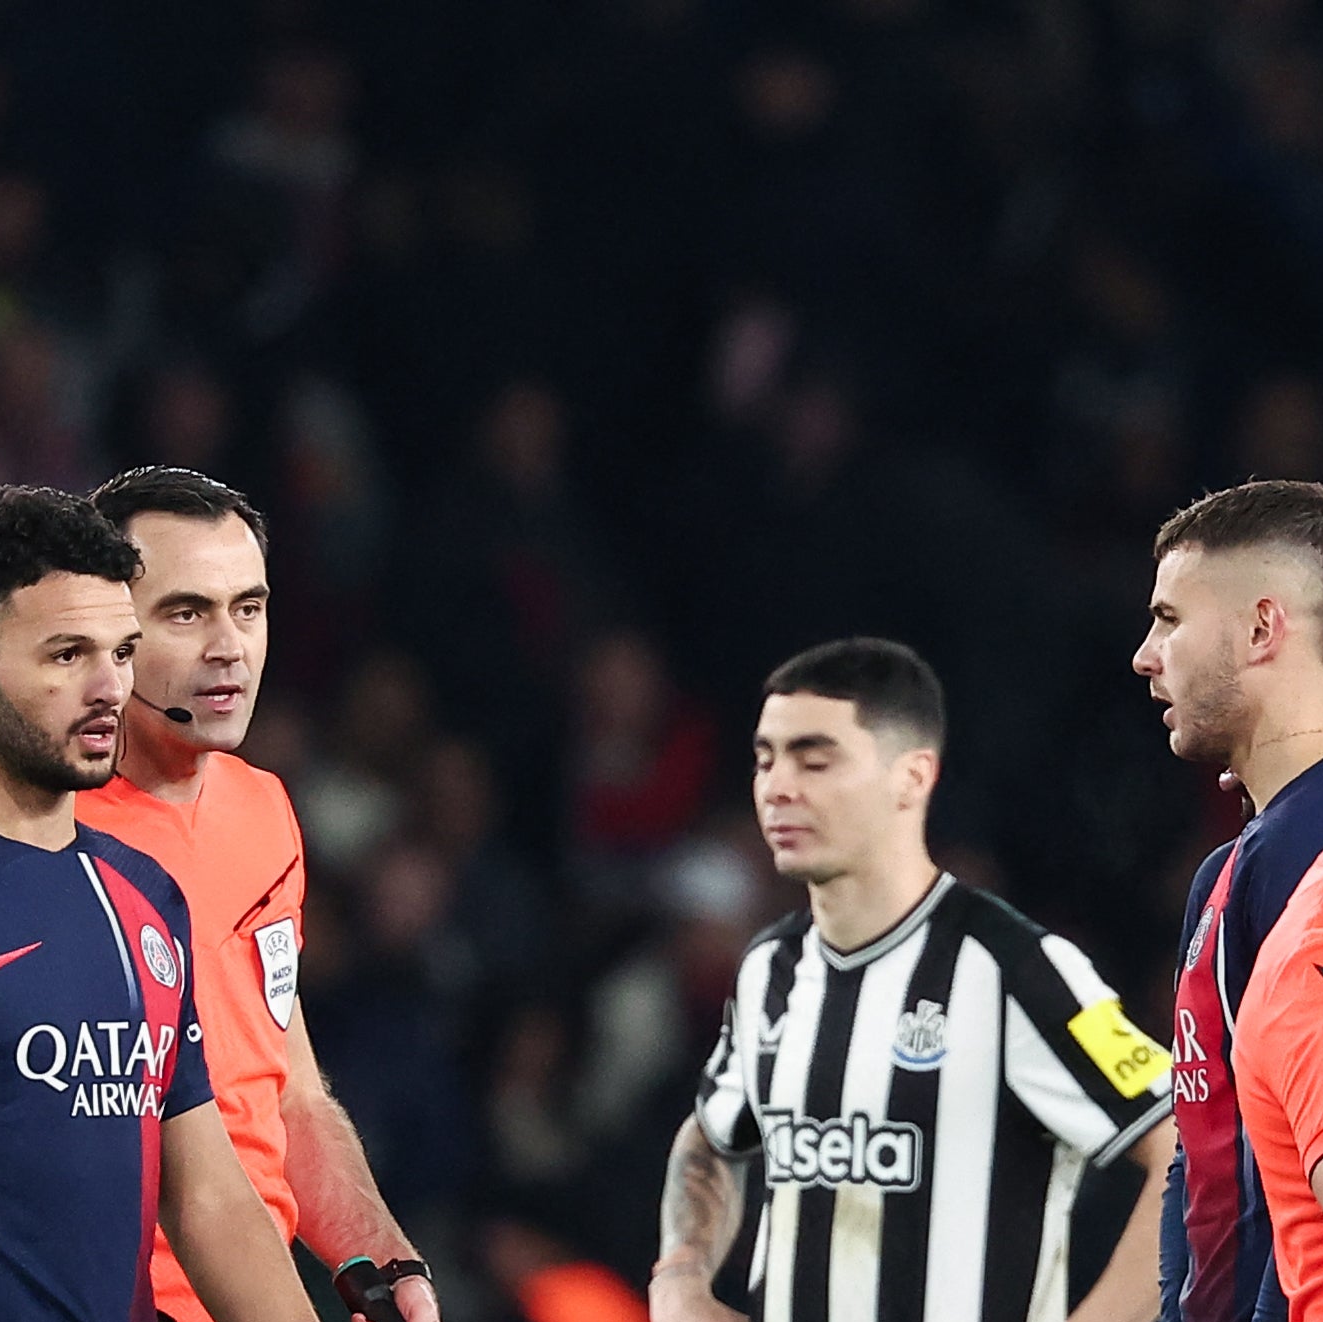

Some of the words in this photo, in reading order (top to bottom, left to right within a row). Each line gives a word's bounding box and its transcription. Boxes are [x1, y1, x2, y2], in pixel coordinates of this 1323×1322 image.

[264, 933, 289, 956] UEFA
[272, 965, 292, 981] MATCH
[269, 985, 293, 999] OFFICIAL
[16, 1021, 176, 1092] QATAR
[793, 1115, 913, 1183] sela
